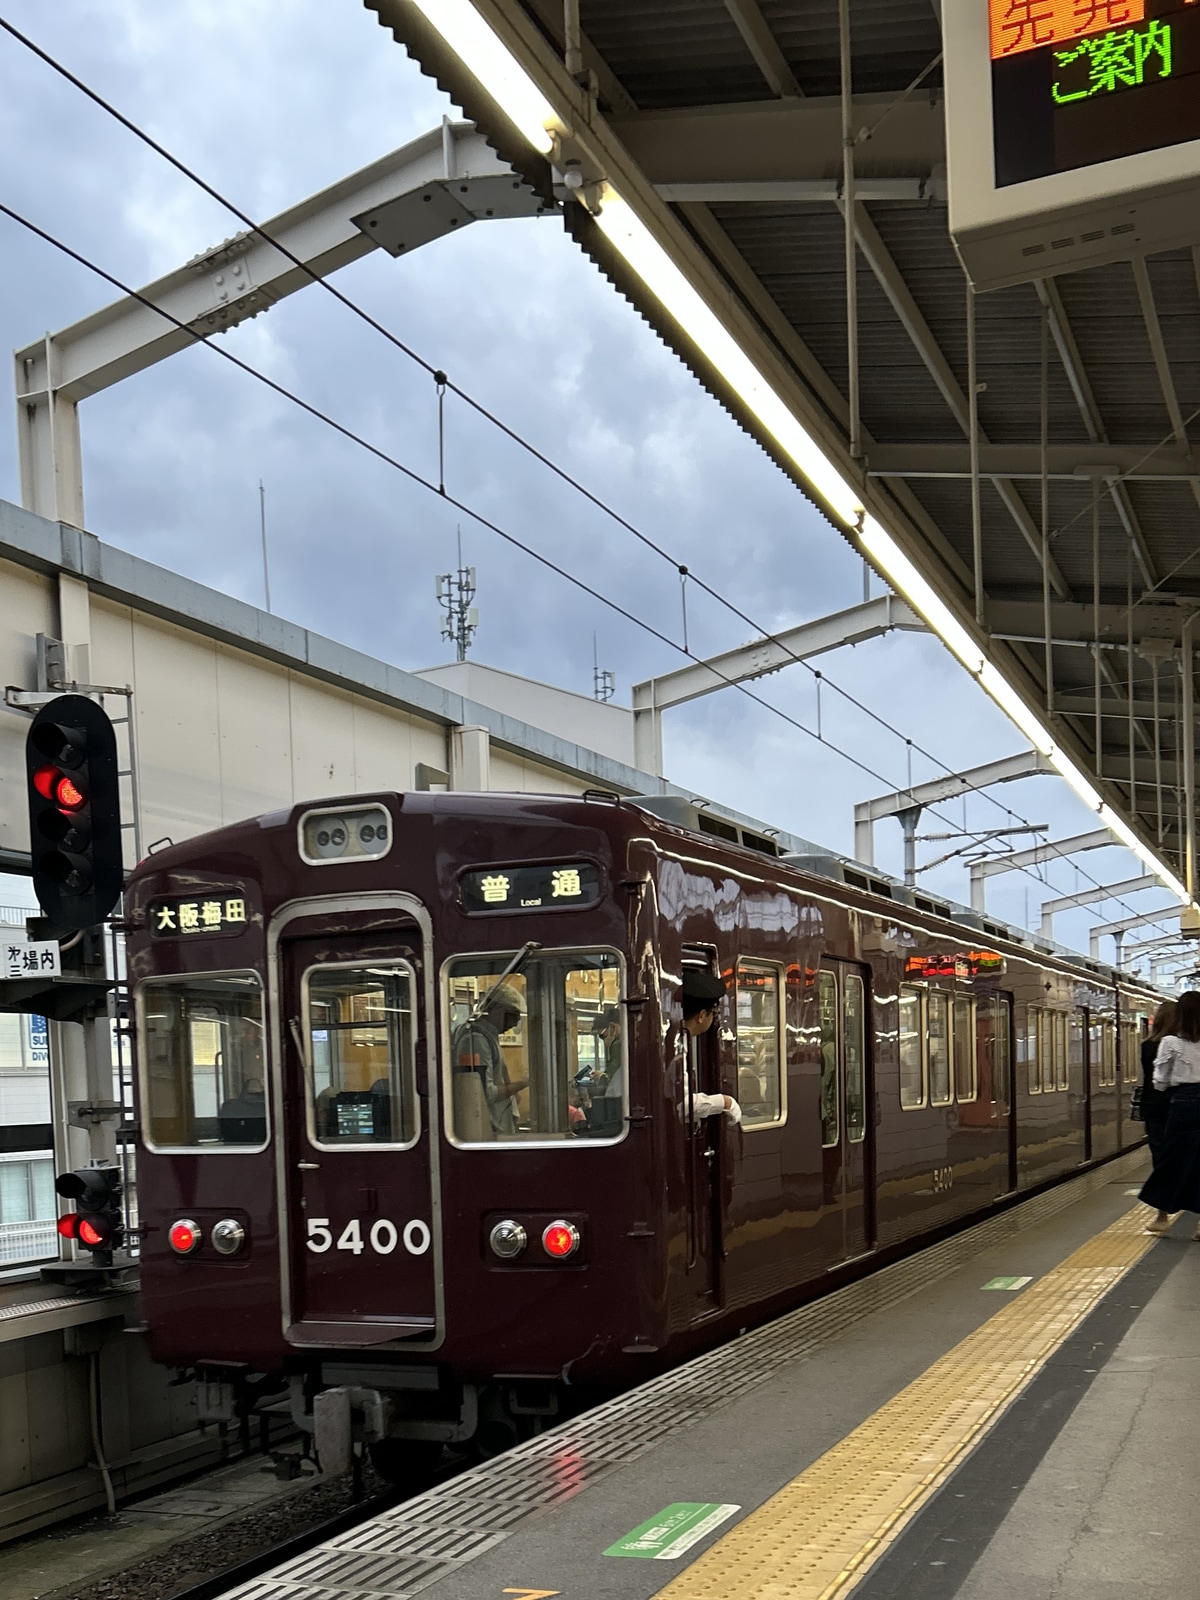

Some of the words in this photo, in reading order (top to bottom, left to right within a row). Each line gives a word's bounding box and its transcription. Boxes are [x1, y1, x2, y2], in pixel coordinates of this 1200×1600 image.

[1052, 20, 1171, 103] ご案内
[481, 869, 582, 902] 普通
[157, 899, 246, 930] 大阪梅田
[520, 898, 541, 907] Local
[306, 1218, 431, 1255] 5400
